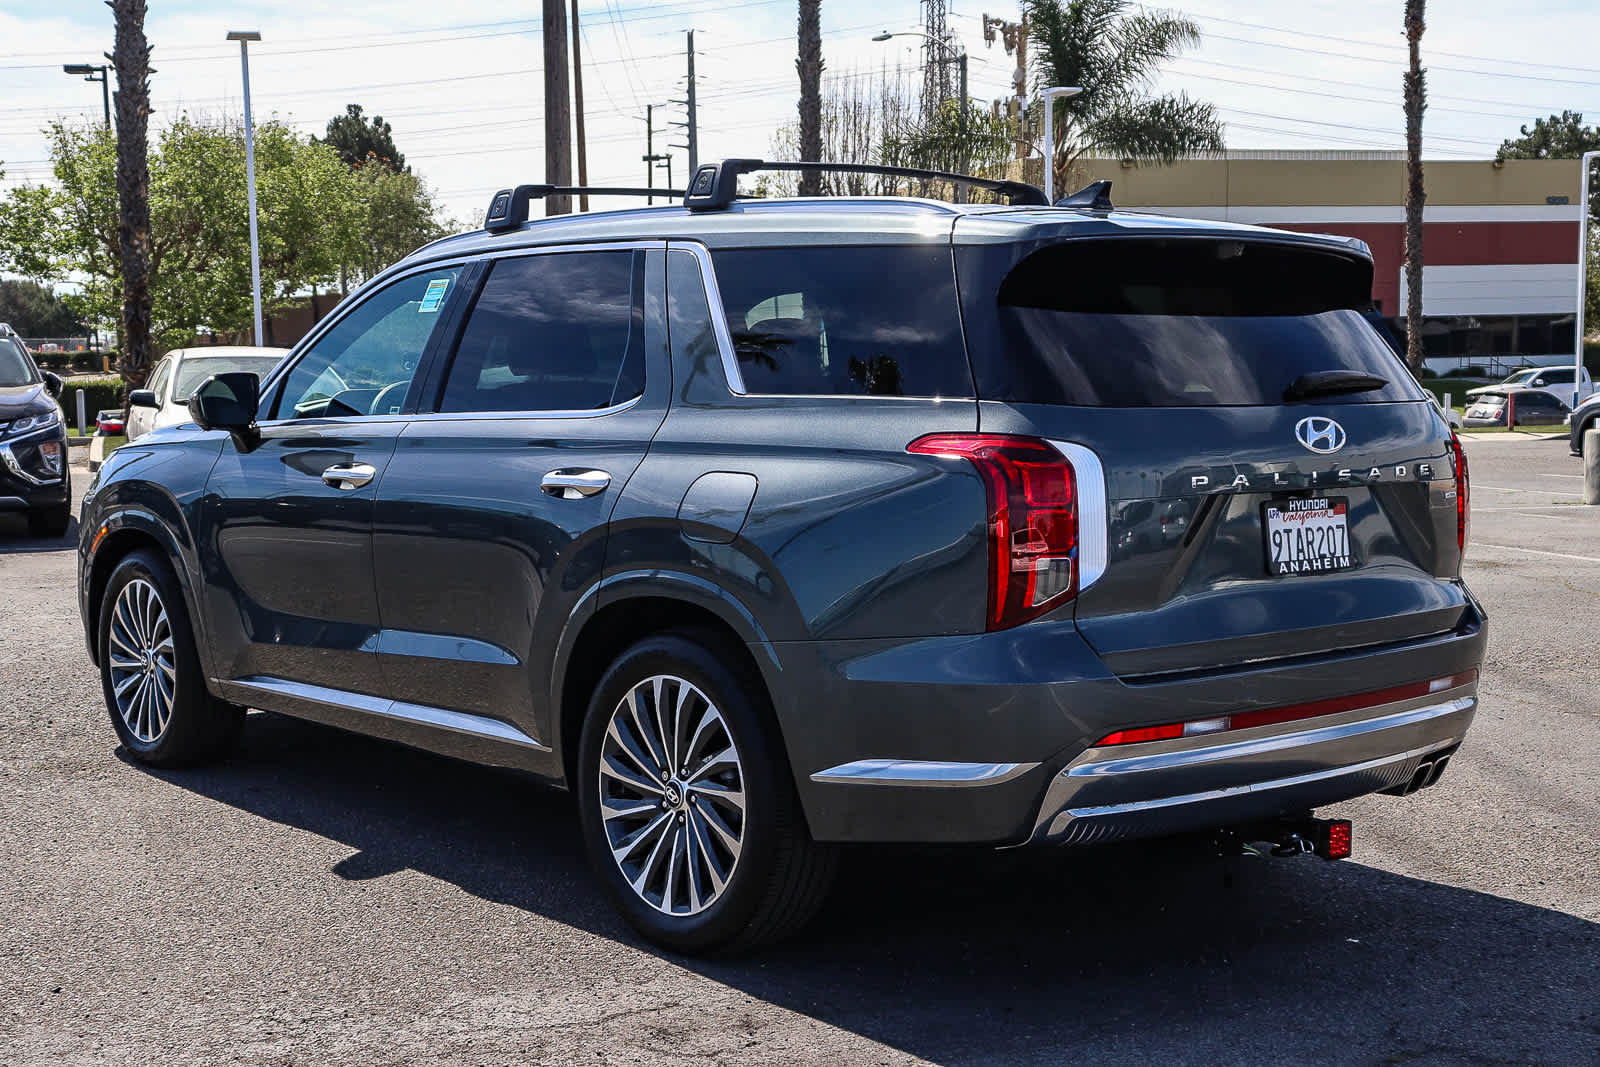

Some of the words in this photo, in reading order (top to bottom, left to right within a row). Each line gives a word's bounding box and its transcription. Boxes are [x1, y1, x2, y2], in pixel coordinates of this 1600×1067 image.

[1191, 463, 1430, 489] PALISADE
[1289, 498, 1329, 511] HYUNDAI
[1272, 524, 1345, 563] 9TAR207
[1279, 557, 1350, 573] ANAHEIM
